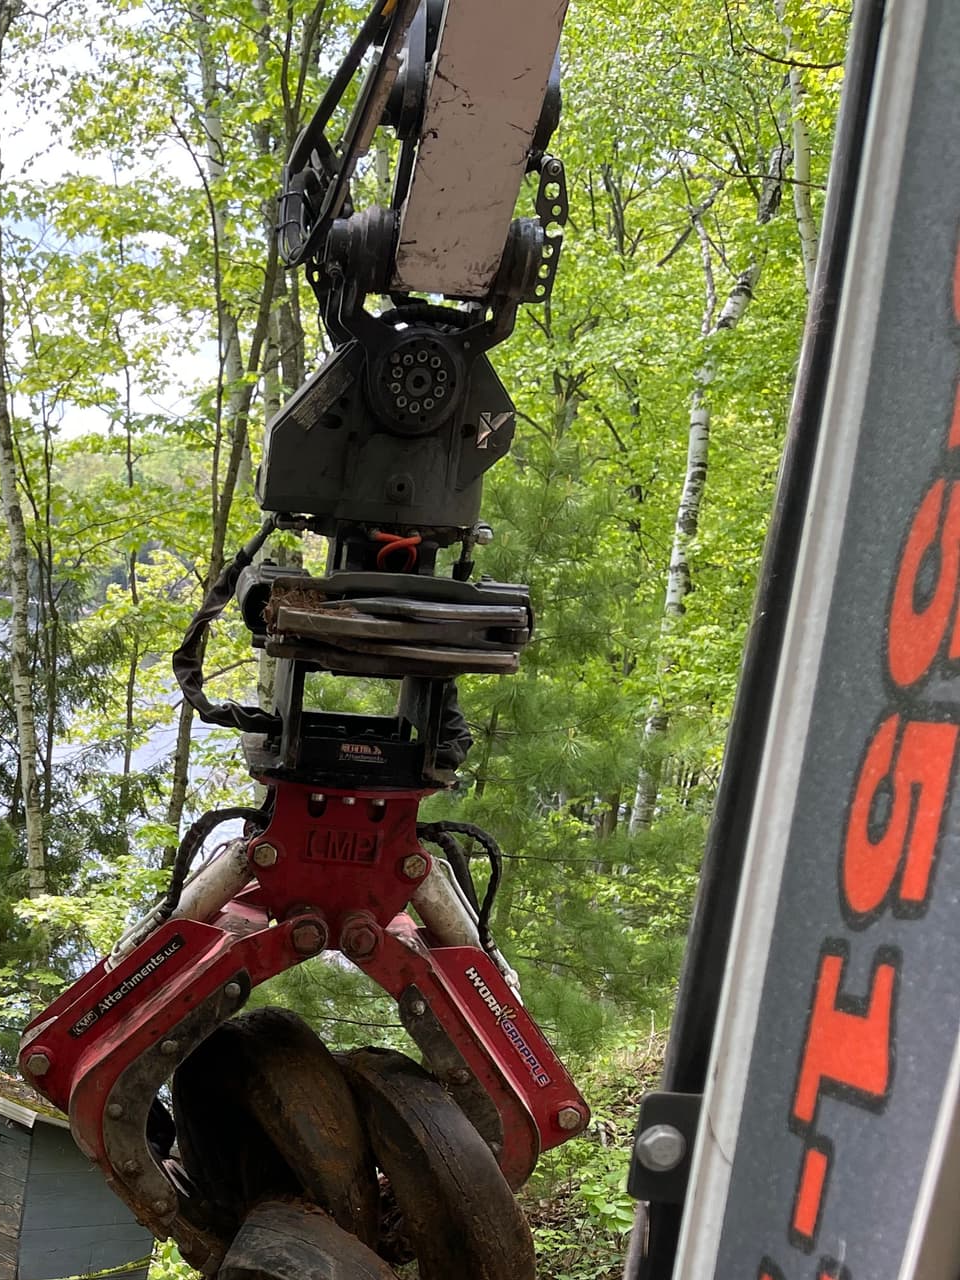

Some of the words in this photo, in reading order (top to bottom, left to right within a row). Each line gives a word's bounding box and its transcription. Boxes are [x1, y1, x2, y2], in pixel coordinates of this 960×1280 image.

[307, 829, 378, 863] CMP
[465, 966, 503, 1018] HYDRA
[501, 1019, 550, 1087] GRAPPLE
